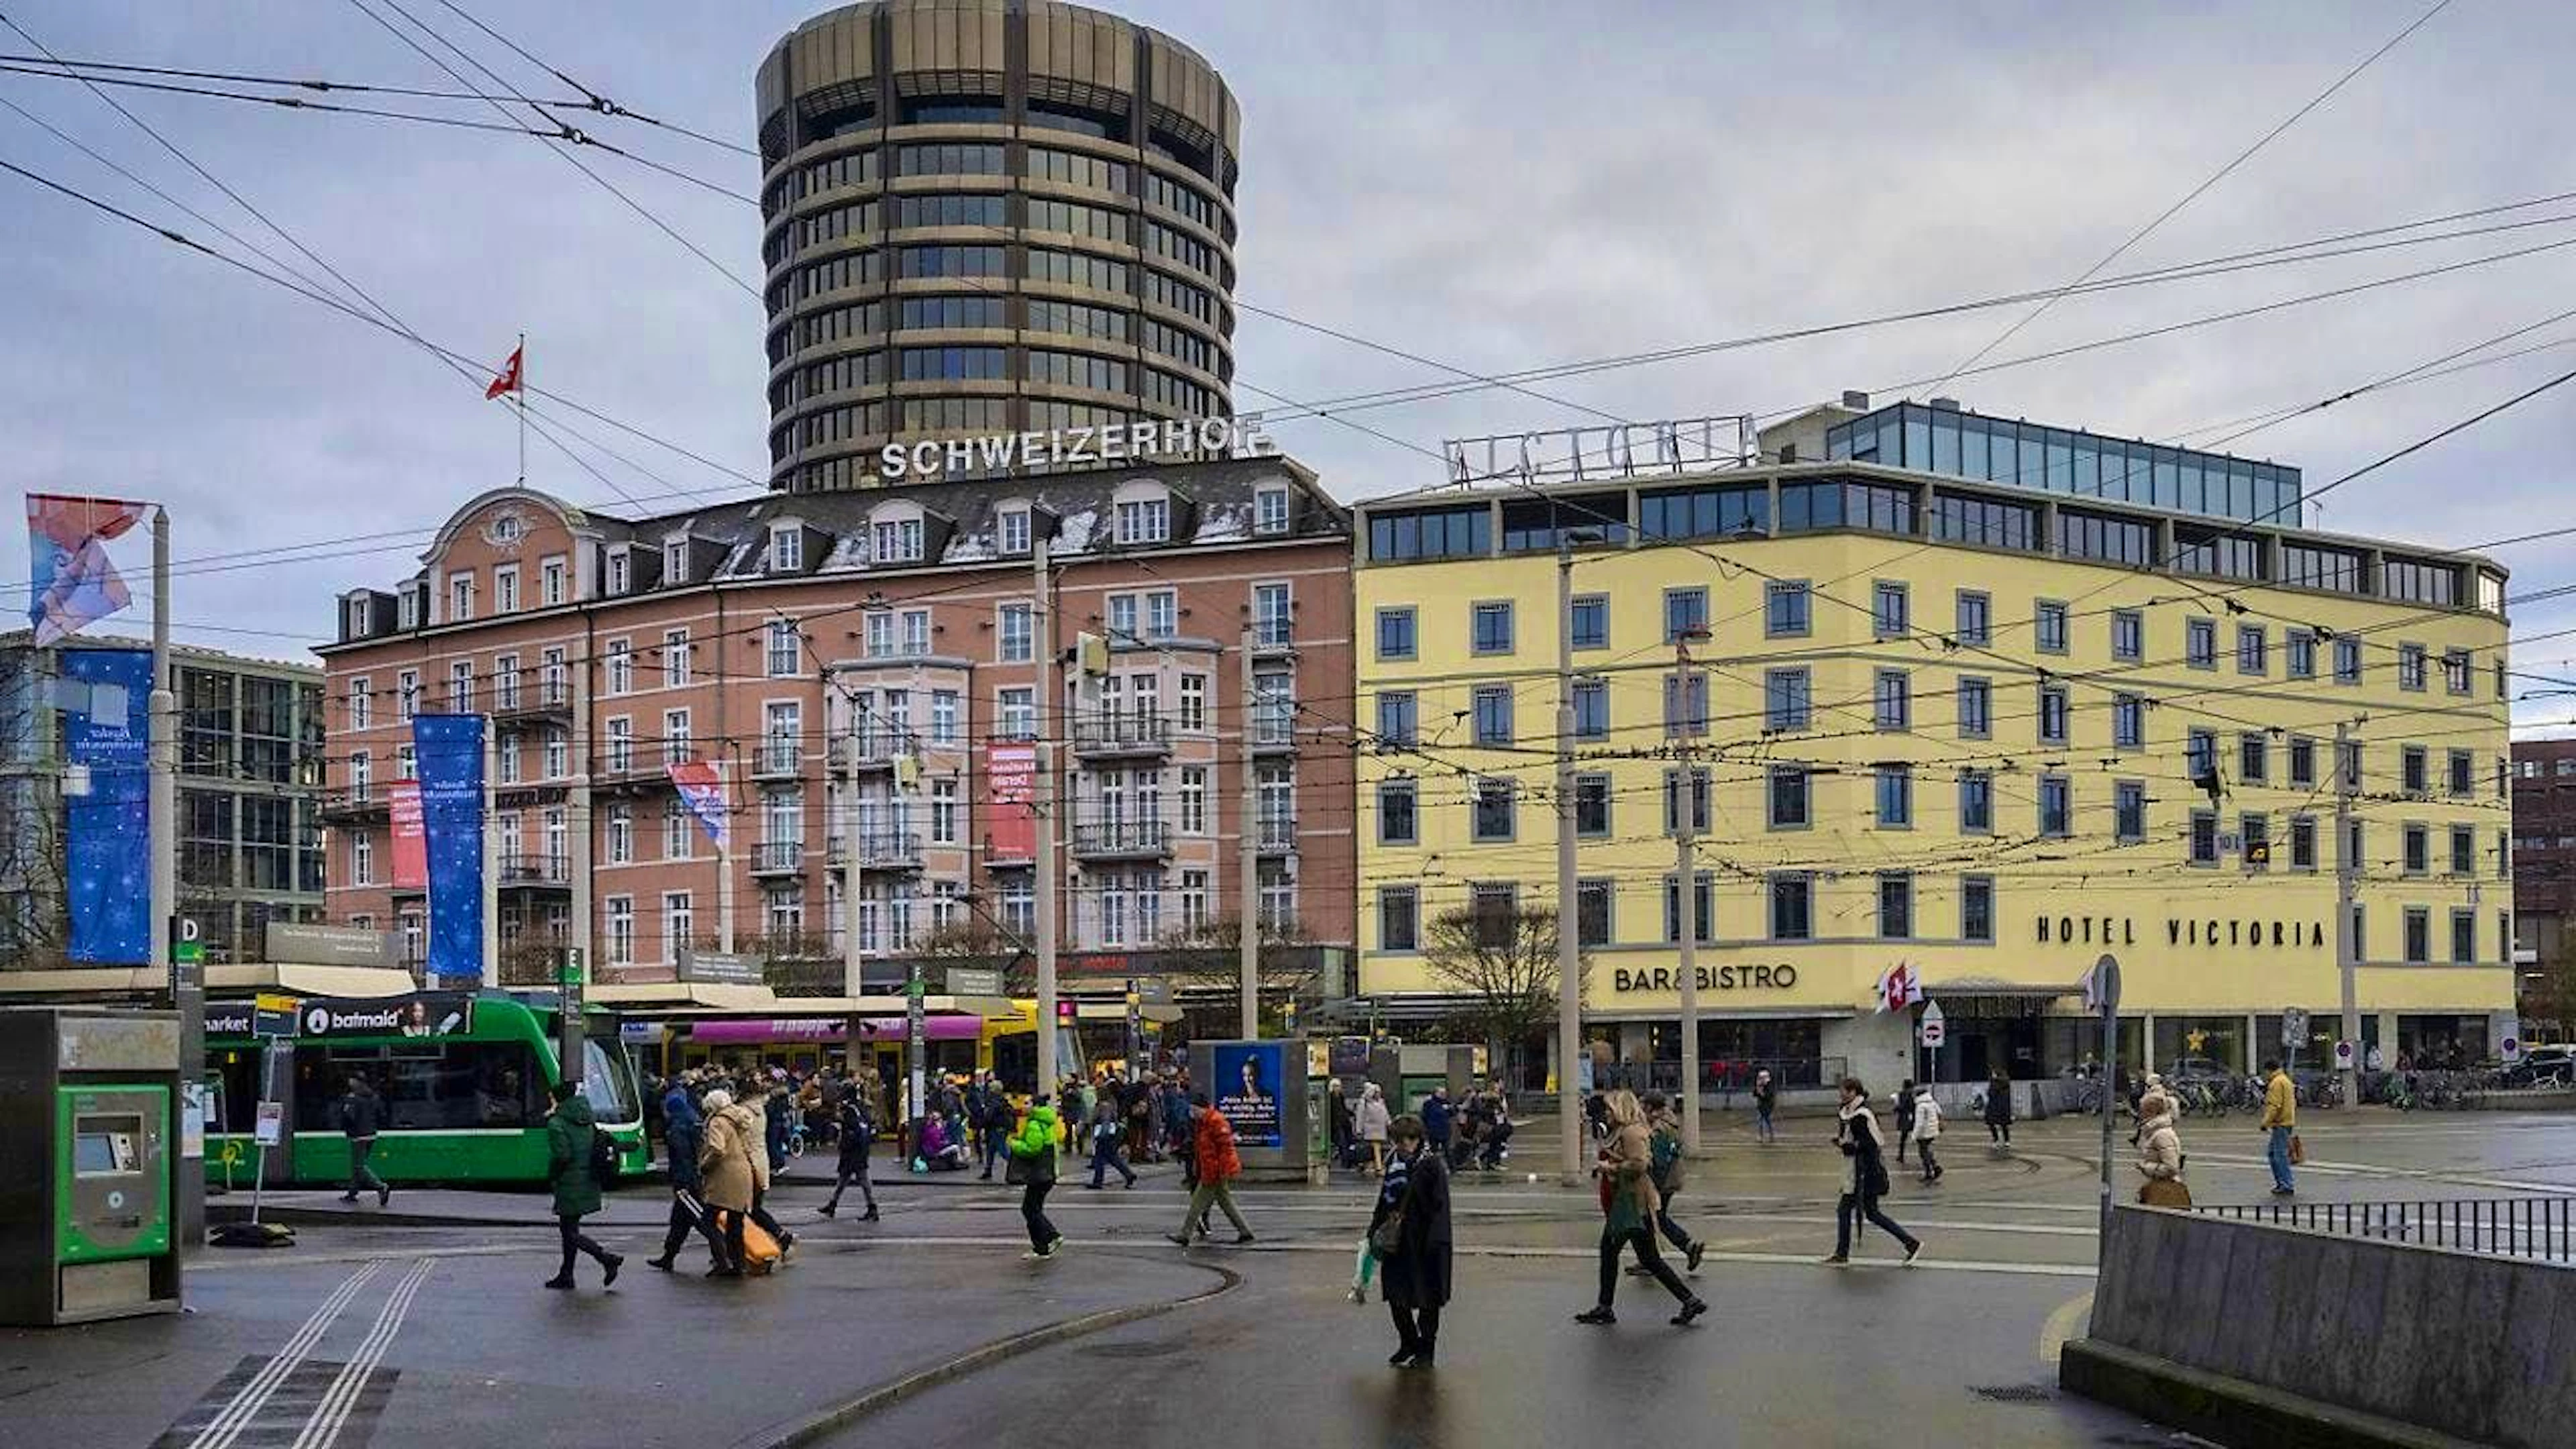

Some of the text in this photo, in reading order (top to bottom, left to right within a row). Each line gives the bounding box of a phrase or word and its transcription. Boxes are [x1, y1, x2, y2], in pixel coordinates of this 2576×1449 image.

[881, 413, 1271, 478] SCHWEIZERHOF
[1442, 413, 1762, 482] VICTORIA
[182, 918, 199, 941] D
[2037, 916, 2323, 946] HOTEL VICTORIA
[568, 948, 577, 967] E
[331, 1010, 398, 1028] batmaid
